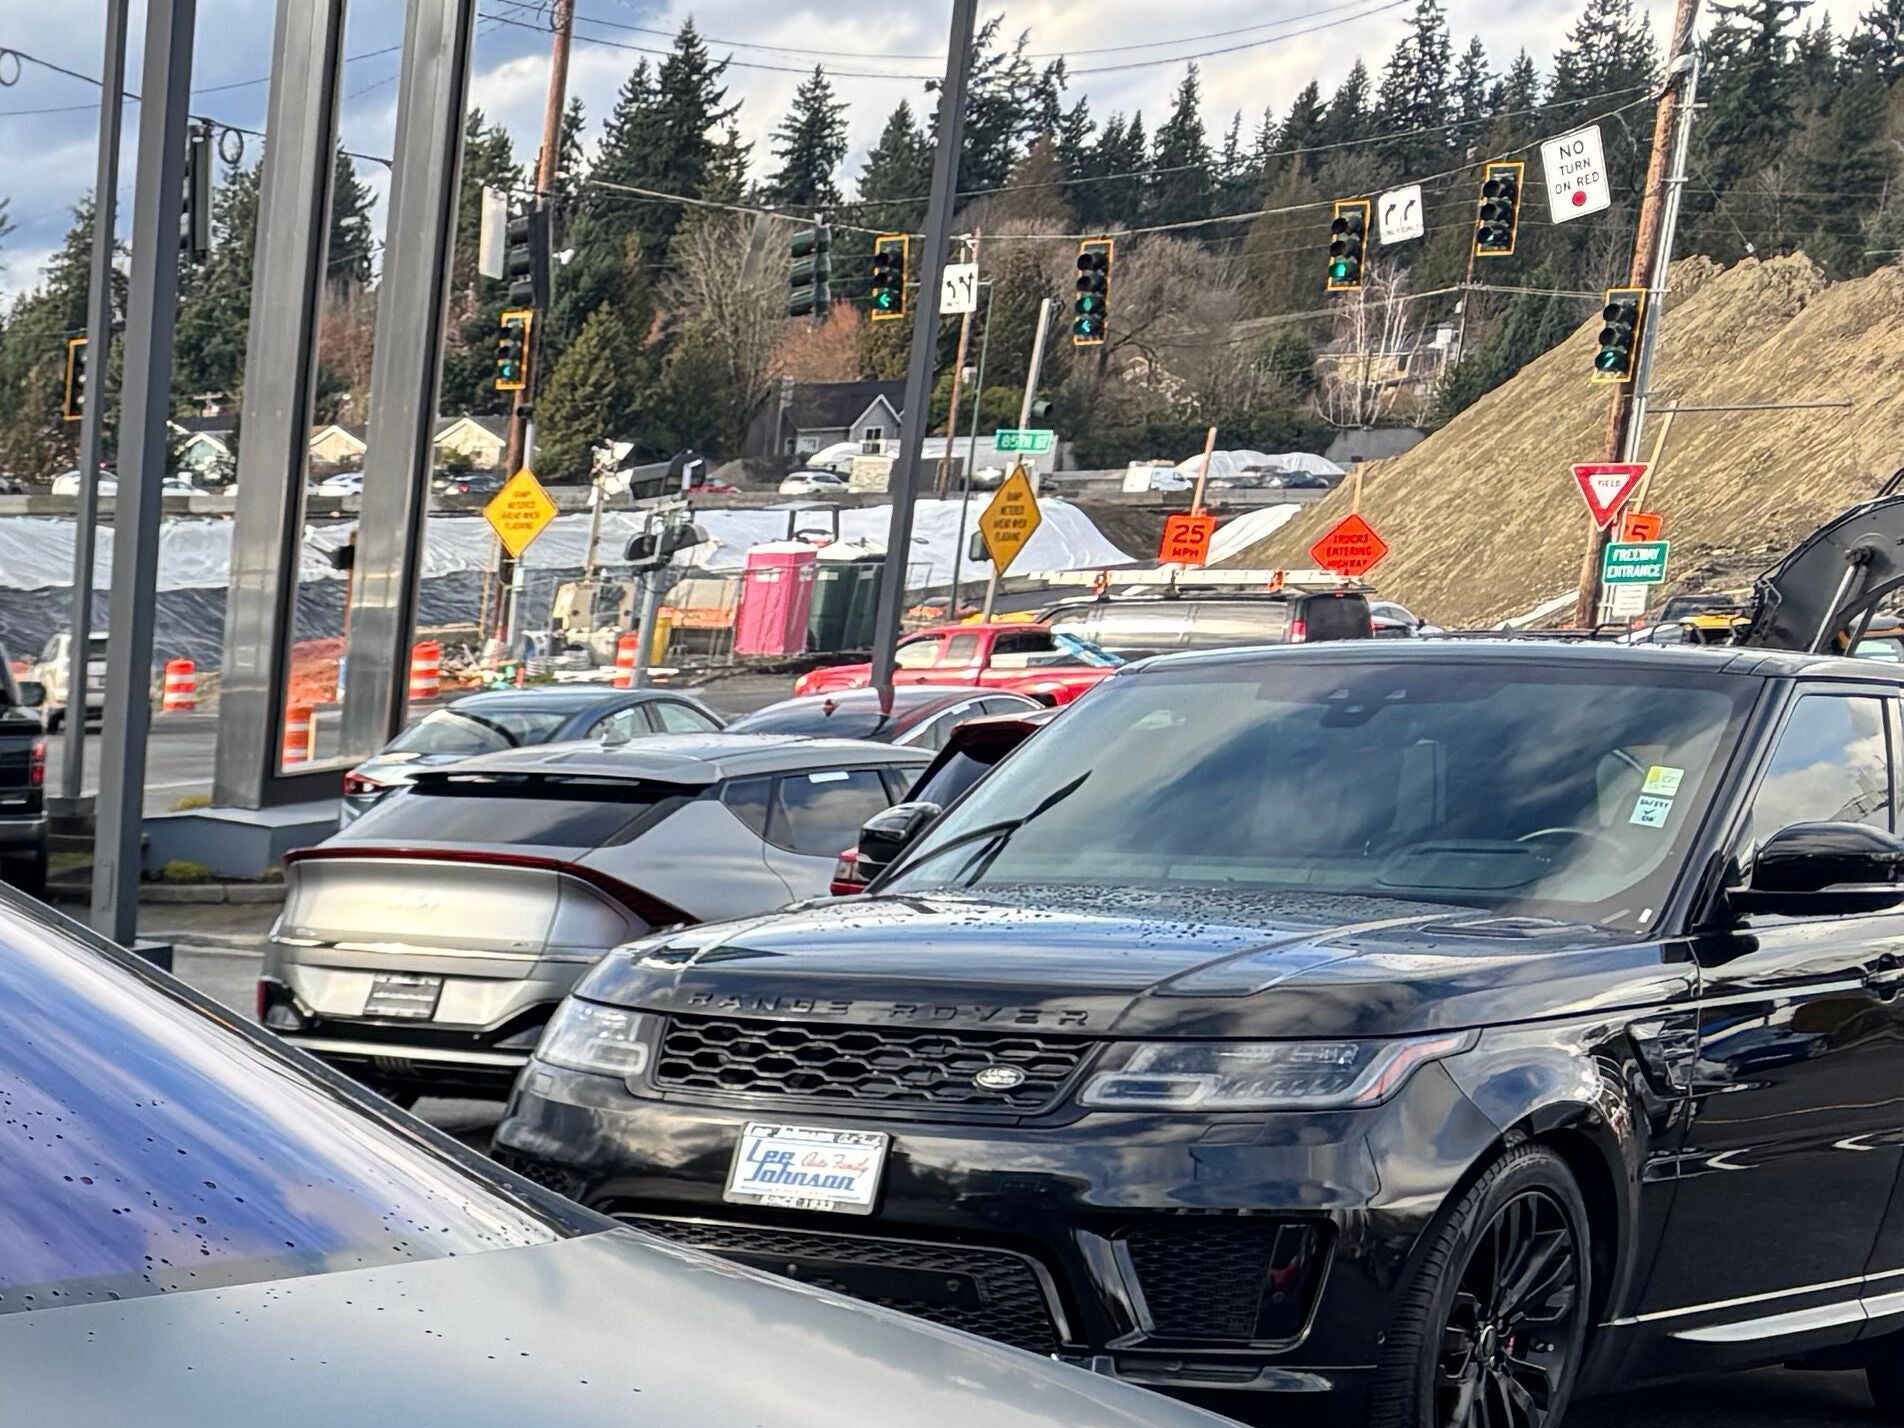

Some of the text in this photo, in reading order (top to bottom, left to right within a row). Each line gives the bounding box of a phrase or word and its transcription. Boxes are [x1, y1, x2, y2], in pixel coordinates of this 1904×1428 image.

[1559, 140, 1584, 160] NO
[1559, 157, 1591, 176] TURN
[1555, 171, 1600, 194] ON RED
[1597, 479, 1621, 488] YIELD
[1173, 524, 1205, 544] 25
[1172, 547, 1199, 558] MPH
[1612, 548, 1661, 562] FREEWAY
[1606, 564, 1662, 579] ENTRANCE
[687, 992, 1089, 1026] RANGE ROVER
[746, 1139, 796, 1166] Lee
[743, 1163, 856, 1191] Johnson
